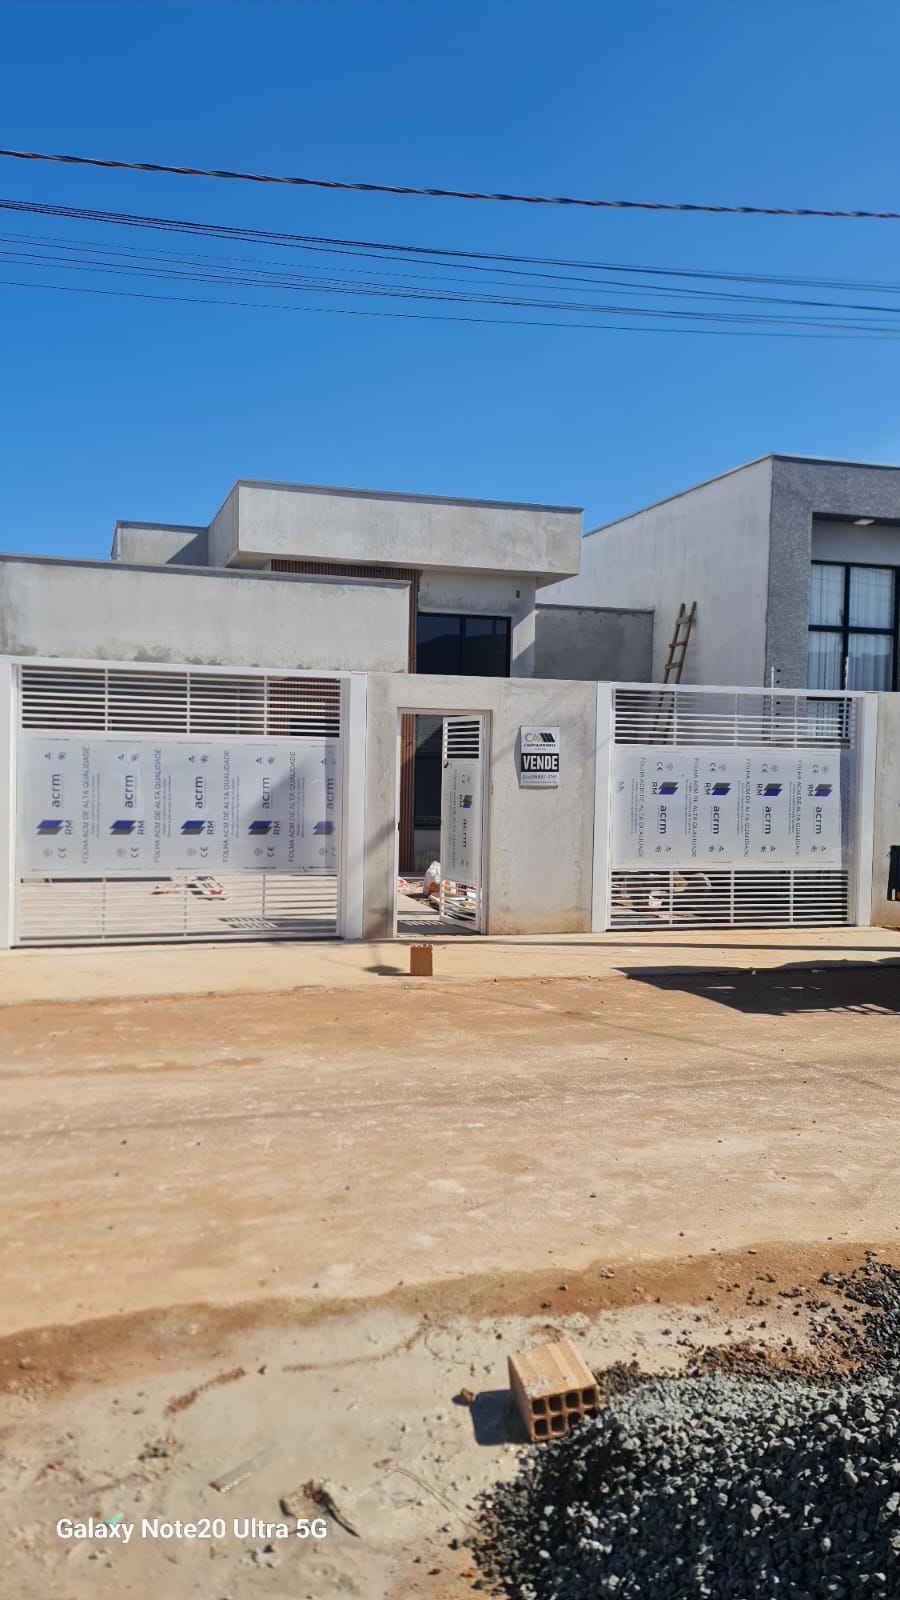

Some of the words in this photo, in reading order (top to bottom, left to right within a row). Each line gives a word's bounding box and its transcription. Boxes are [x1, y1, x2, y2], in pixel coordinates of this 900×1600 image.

[82, 746, 90, 788] QUALIDADE
[288, 751, 296, 791] QUALIDADE
[523, 755, 558, 770] VENDE
[51, 773, 61, 808] acrm
[82, 790, 90, 808] ALTA
[124, 775, 134, 808] acrm
[194, 776, 203, 809] acrm
[262, 777, 270, 809] acrm
[288, 792, 296, 809] ALTA
[326, 778, 335, 810] acrm
[82, 810, 90, 820] DE
[154, 810, 161, 820] DE
[223, 811, 230, 821] DE
[288, 811, 296, 821] DE
[82, 821, 90, 838] ACM
[288, 822, 296, 838] ACM
[82, 839, 90, 864] FOLHA
[288, 839, 296, 863] FOLHA
